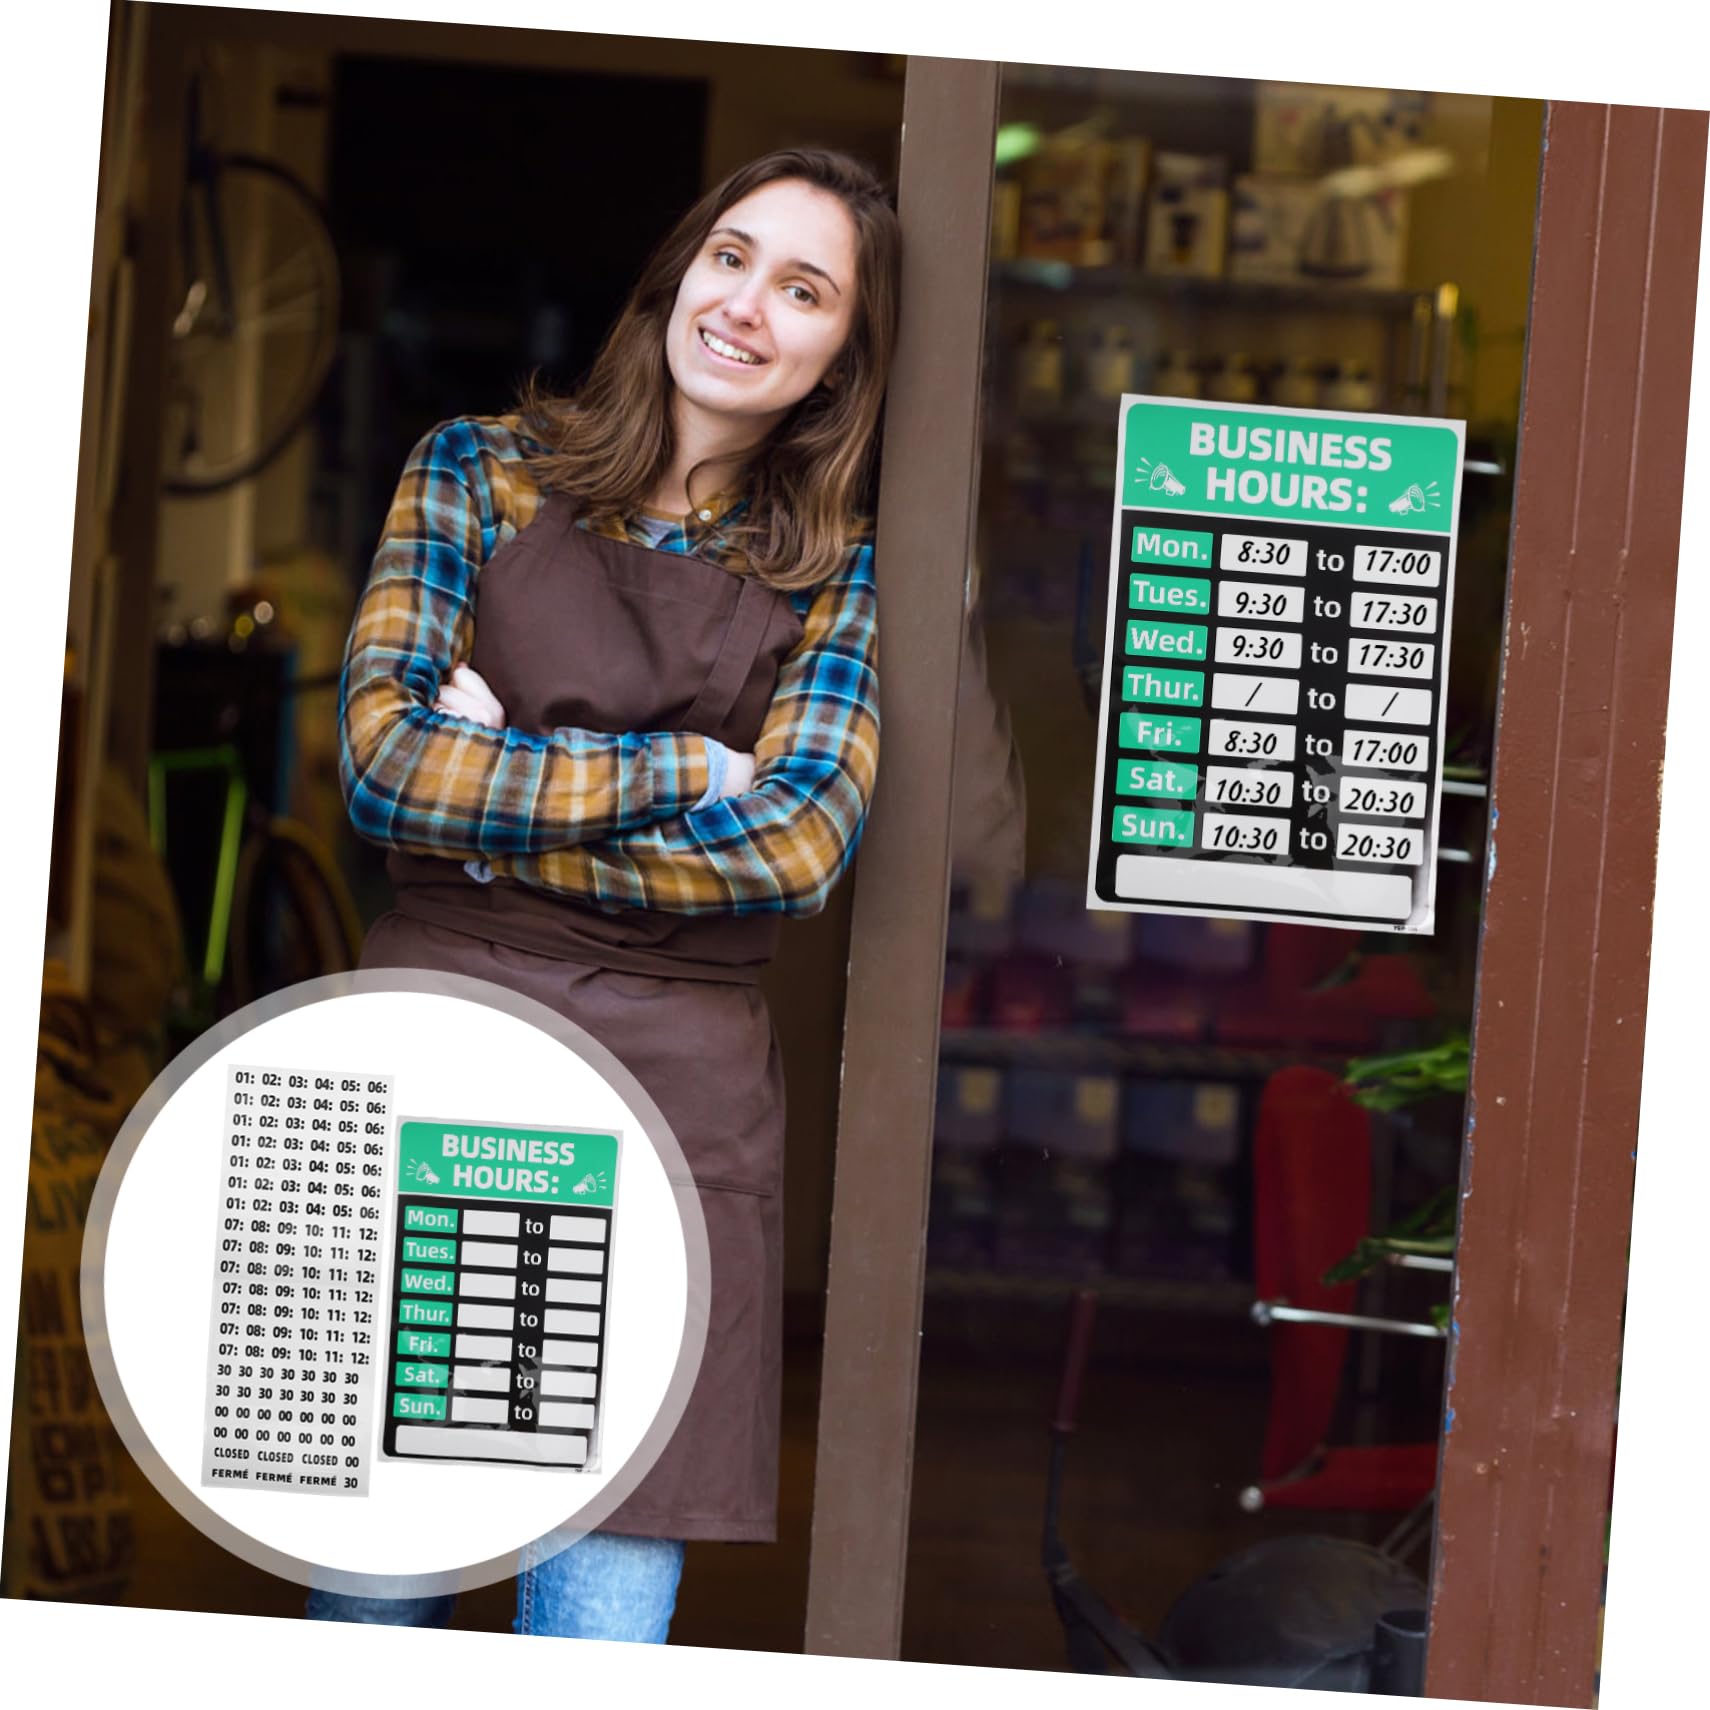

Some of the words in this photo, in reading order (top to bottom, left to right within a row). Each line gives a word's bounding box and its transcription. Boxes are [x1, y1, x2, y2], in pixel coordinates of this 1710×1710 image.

[1190, 422, 1393, 471] BUSINESS
[1206, 467, 1367, 512] HOURS:
[1138, 533, 1206, 560] Mon.
[1238, 540, 1291, 565] 8:30
[1317, 550, 1344, 571] to
[1367, 550, 1430, 575] 17:00
[1134, 581, 1205, 607] Tues.
[1234, 592, 1287, 616] 9:30
[1314, 597, 1341, 617] to
[1363, 601, 1427, 625] 17:30
[1132, 628, 1202, 654] Wed.
[1232, 635, 1284, 660] 9:30
[1311, 643, 1337, 664] to
[1360, 644, 1425, 669] 17:30
[1128, 674, 1198, 699] Thur.
[1308, 689, 1335, 709] to
[1138, 722, 1181, 745] Fri.
[1223, 731, 1277, 756] 8:30
[1305, 735, 1332, 756] to
[1354, 740, 1417, 764] 17:00
[1131, 768, 1183, 792] Sat.
[1217, 779, 1280, 804] 10:30
[1302, 781, 1330, 802] to
[1344, 788, 1414, 814] 20:30
[1123, 814, 1184, 839] Sun.
[1214, 825, 1277, 850] 10:30
[1300, 828, 1326, 849] to
[1341, 834, 1410, 860] 20:30
[235, 1071, 255, 1084] 01:
[262, 1073, 281, 1086] 02:
[289, 1075, 308, 1088] 03:
[315, 1078, 334, 1090] 04:
[341, 1080, 360, 1092] 05:
[368, 1081, 387, 1093] 06:
[233, 1114, 252, 1126] 01:
[259, 1115, 278, 1128] 02:
[285, 1117, 305, 1129] 03:
[312, 1119, 331, 1131] 04:
[338, 1120, 358, 1133] 05:
[365, 1122, 384, 1135] 06:
[231, 1134, 251, 1147] 01:
[258, 1136, 277, 1148] 02:
[284, 1138, 303, 1150] 03:
[310, 1139, 330, 1152] 04:
[337, 1141, 356, 1154] 05:
[364, 1143, 383, 1156] 06:
[443, 1134, 575, 1165] BUSINESS
[230, 1155, 249, 1168] 01:
[256, 1156, 275, 1169] 02:
[283, 1158, 302, 1171] 03:
[309, 1160, 328, 1173] 04:
[336, 1162, 355, 1174] 05:
[363, 1164, 382, 1176] 06:
[228, 1176, 247, 1189] 01:
[254, 1178, 274, 1191] 02:
[281, 1180, 300, 1192] 03:
[307, 1181, 327, 1194] 04:
[334, 1183, 354, 1196] 05:
[361, 1185, 380, 1198] 06:
[453, 1164, 559, 1194] HOURS:
[226, 1197, 245, 1210] 01:
[253, 1199, 272, 1212] 02:
[279, 1201, 299, 1214] 03:
[306, 1203, 325, 1216] 04:
[333, 1204, 352, 1218] 05:
[360, 1206, 379, 1219] 06:
[408, 1210, 453, 1226] Mon.
[526, 1219, 543, 1234] to
[407, 1242, 452, 1258] Tues.
[524, 1251, 541, 1265] to
[220, 1260, 240, 1274] 07:
[247, 1262, 267, 1275] 08:
[274, 1264, 294, 1277] 09:
[302, 1266, 320, 1280] 10:
[329, 1268, 348, 1282] 11:
[356, 1270, 375, 1284] 12:
[223, 1282, 242, 1294] 07:
[249, 1283, 268, 1296] 08:
[275, 1285, 295, 1298] 09:
[302, 1287, 321, 1300] 10:
[328, 1289, 347, 1301] 11:
[355, 1291, 373, 1303] 12:
[406, 1274, 451, 1290] Wed.
[522, 1282, 539, 1296] to
[221, 1302, 240, 1315] 07:
[247, 1303, 267, 1316] 08:
[274, 1305, 293, 1318] 09:
[301, 1307, 319, 1320] 10:
[327, 1309, 346, 1322] 11:
[353, 1311, 372, 1323] 12:
[404, 1305, 448, 1321] Thur.
[520, 1313, 538, 1327] to
[220, 1322, 239, 1335] 07:
[246, 1324, 265, 1337] 08:
[273, 1326, 292, 1339] 09:
[300, 1328, 318, 1341] 10:
[326, 1330, 344, 1342] 11:
[352, 1331, 371, 1344] 12:
[219, 1343, 238, 1356] 07:
[245, 1345, 264, 1358] 08:
[271, 1347, 291, 1360] 09:
[299, 1349, 317, 1361] 10:
[325, 1350, 343, 1363] 11:
[351, 1352, 369, 1365] 12:
[410, 1336, 437, 1352] Fri.
[519, 1343, 536, 1358] to
[217, 1364, 232, 1376] 30
[238, 1365, 253, 1377] 30
[260, 1367, 274, 1379] 30
[281, 1368, 295, 1380] 30
[301, 1370, 316, 1382] 30
[322, 1371, 337, 1383] 30
[345, 1372, 359, 1384] 30
[406, 1367, 439, 1383] Sat.
[517, 1374, 534, 1389] to
[216, 1384, 230, 1397] 30
[237, 1386, 251, 1398] 30
[258, 1387, 273, 1400] 30
[279, 1389, 294, 1401] 30
[300, 1390, 314, 1402] 30
[321, 1392, 336, 1404] 30
[343, 1393, 358, 1405] 30
[215, 1406, 229, 1418] 00
[236, 1407, 250, 1419] 00
[257, 1409, 271, 1420] 00
[278, 1410, 293, 1422] 00
[300, 1411, 314, 1423] 00
[321, 1413, 335, 1424] 00
[342, 1414, 356, 1426] 00
[400, 1398, 440, 1414] Sun.
[515, 1406, 532, 1419] to
[213, 1426, 228, 1438] 00
[234, 1428, 249, 1440] 00
[256, 1430, 270, 1441] 00
[277, 1431, 291, 1443] 00
[298, 1432, 313, 1444] 00
[320, 1434, 334, 1445] 00
[341, 1435, 355, 1447] 00
[214, 1447, 250, 1460] CLOSED
[257, 1451, 294, 1463] CLOSED
[302, 1454, 338, 1466] CLOSED
[345, 1456, 359, 1468] 00
[212, 1468, 248, 1479] FERMÉ
[256, 1472, 292, 1483] FERMÉ
[300, 1475, 337, 1486] FERMÉ
[344, 1477, 358, 1489] 30
